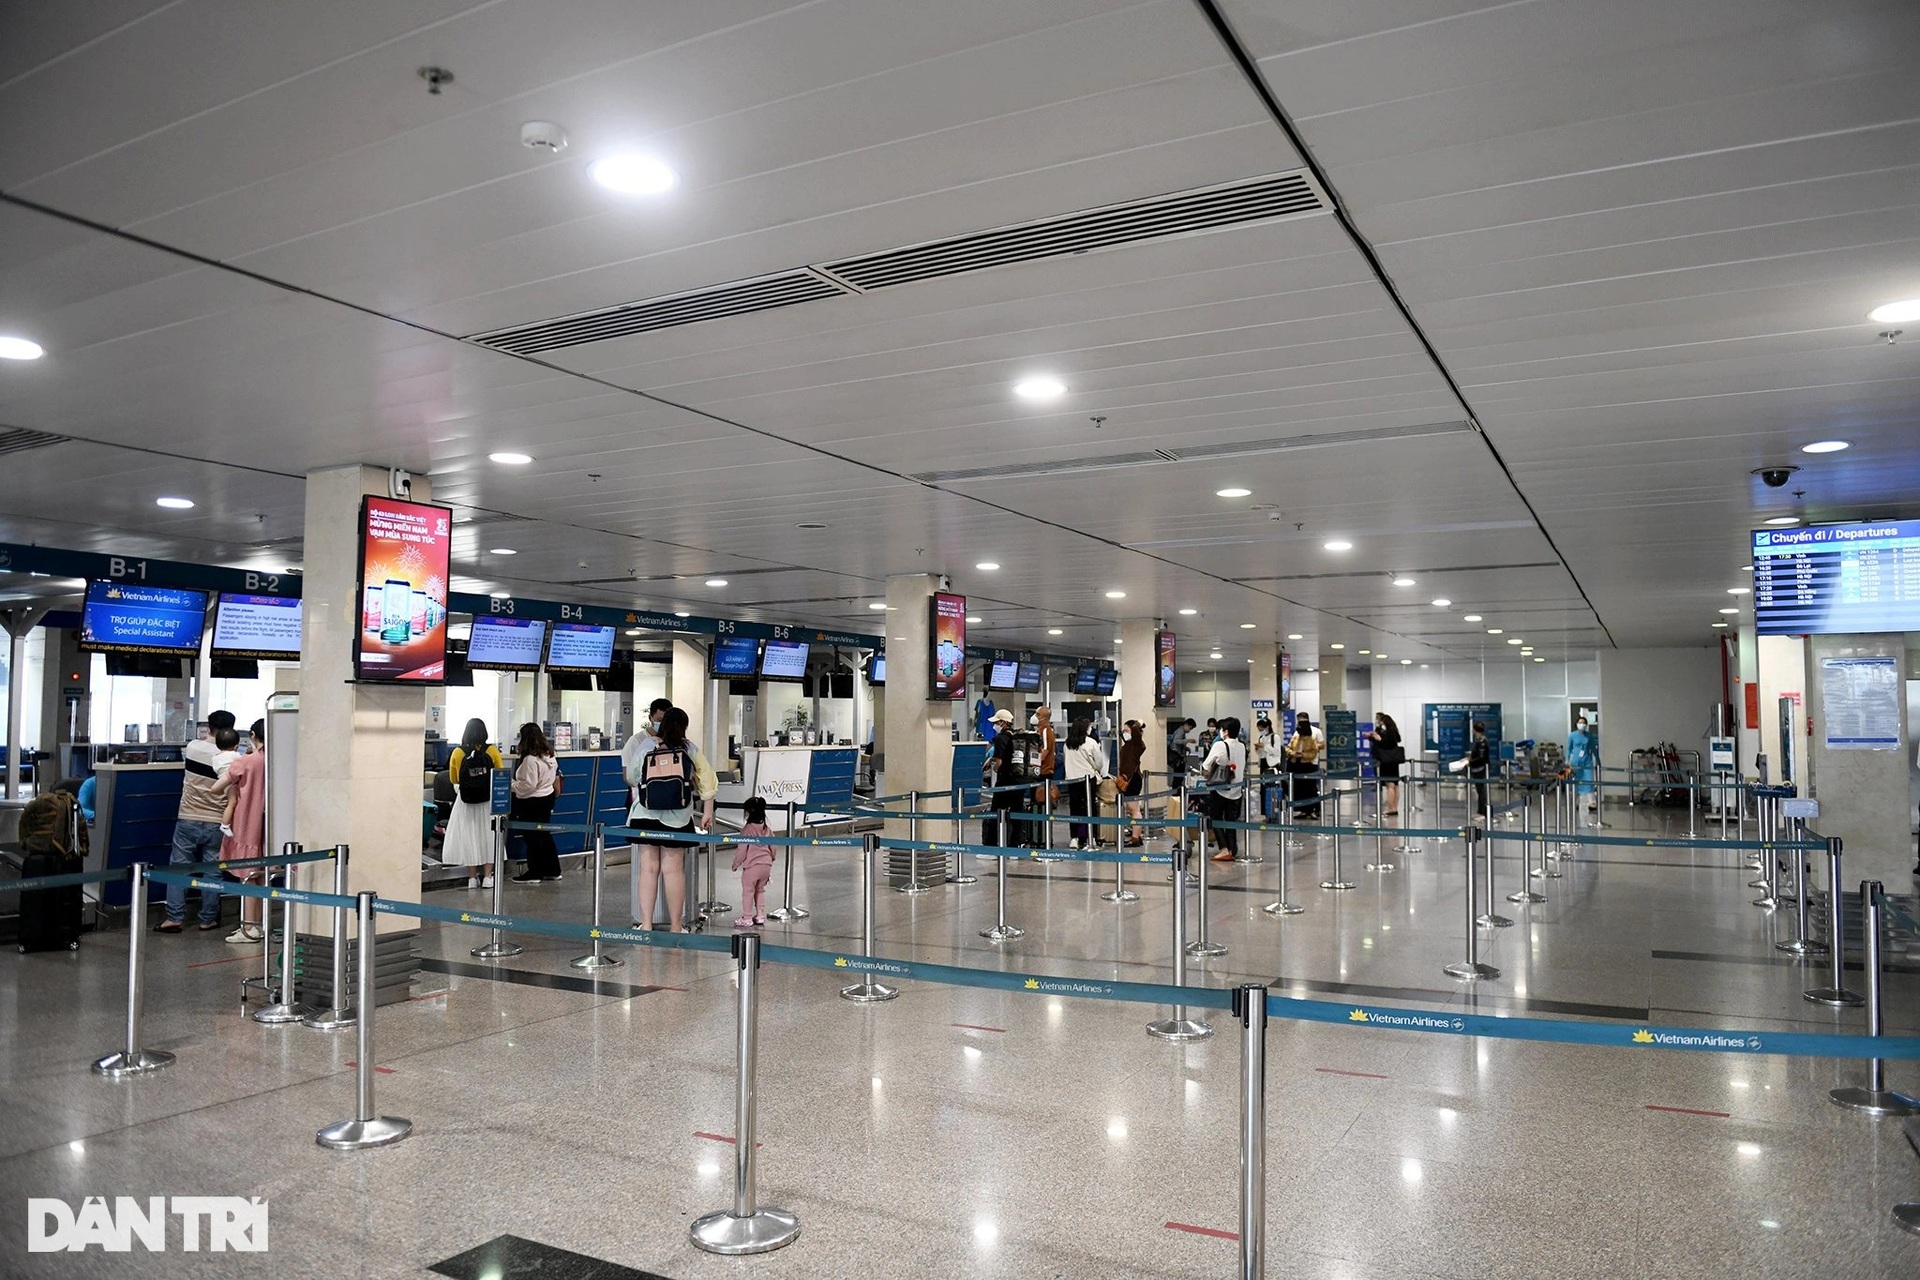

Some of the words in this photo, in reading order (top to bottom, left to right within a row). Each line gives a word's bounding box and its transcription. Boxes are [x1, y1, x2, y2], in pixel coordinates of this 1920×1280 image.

[370, 518, 392, 529] MỪNG
[394, 522, 411, 532] MIỀN
[370, 529, 384, 538] VẠN
[385, 530, 401, 540] MÙA
[402, 534, 420, 542] SUNG
[421, 534, 435, 544] TÚC
[1772, 530, 1812, 544] Chuyến
[1814, 530, 1826, 540] đi
[1836, 528, 1898, 540] Departures
[110, 557, 147, 580] B-1
[245, 572, 279, 592] B-2
[491, 598, 514, 614] B-3
[562, 605, 582, 620] B-4
[110, 615, 127, 625] TRỢ
[127, 615, 146, 625] GIÚP
[147, 618, 164, 628] ĐẶC
[164, 620, 180, 629] BIỆT
[718, 620, 734, 633] B-5
[114, 626, 140, 636] Special
[142, 628, 174, 638] Assistant
[774, 626, 789, 639] B-6
[139, 646, 173, 654] declarations
[1330, 736, 1347, 746] 40
[1369, 1013, 1410, 1025] Vietnam
[1411, 1017, 1449, 1028] Airlines
[1654, 1033, 1701, 1045] Vietnam
[1701, 1036, 1744, 1047] Airlines
